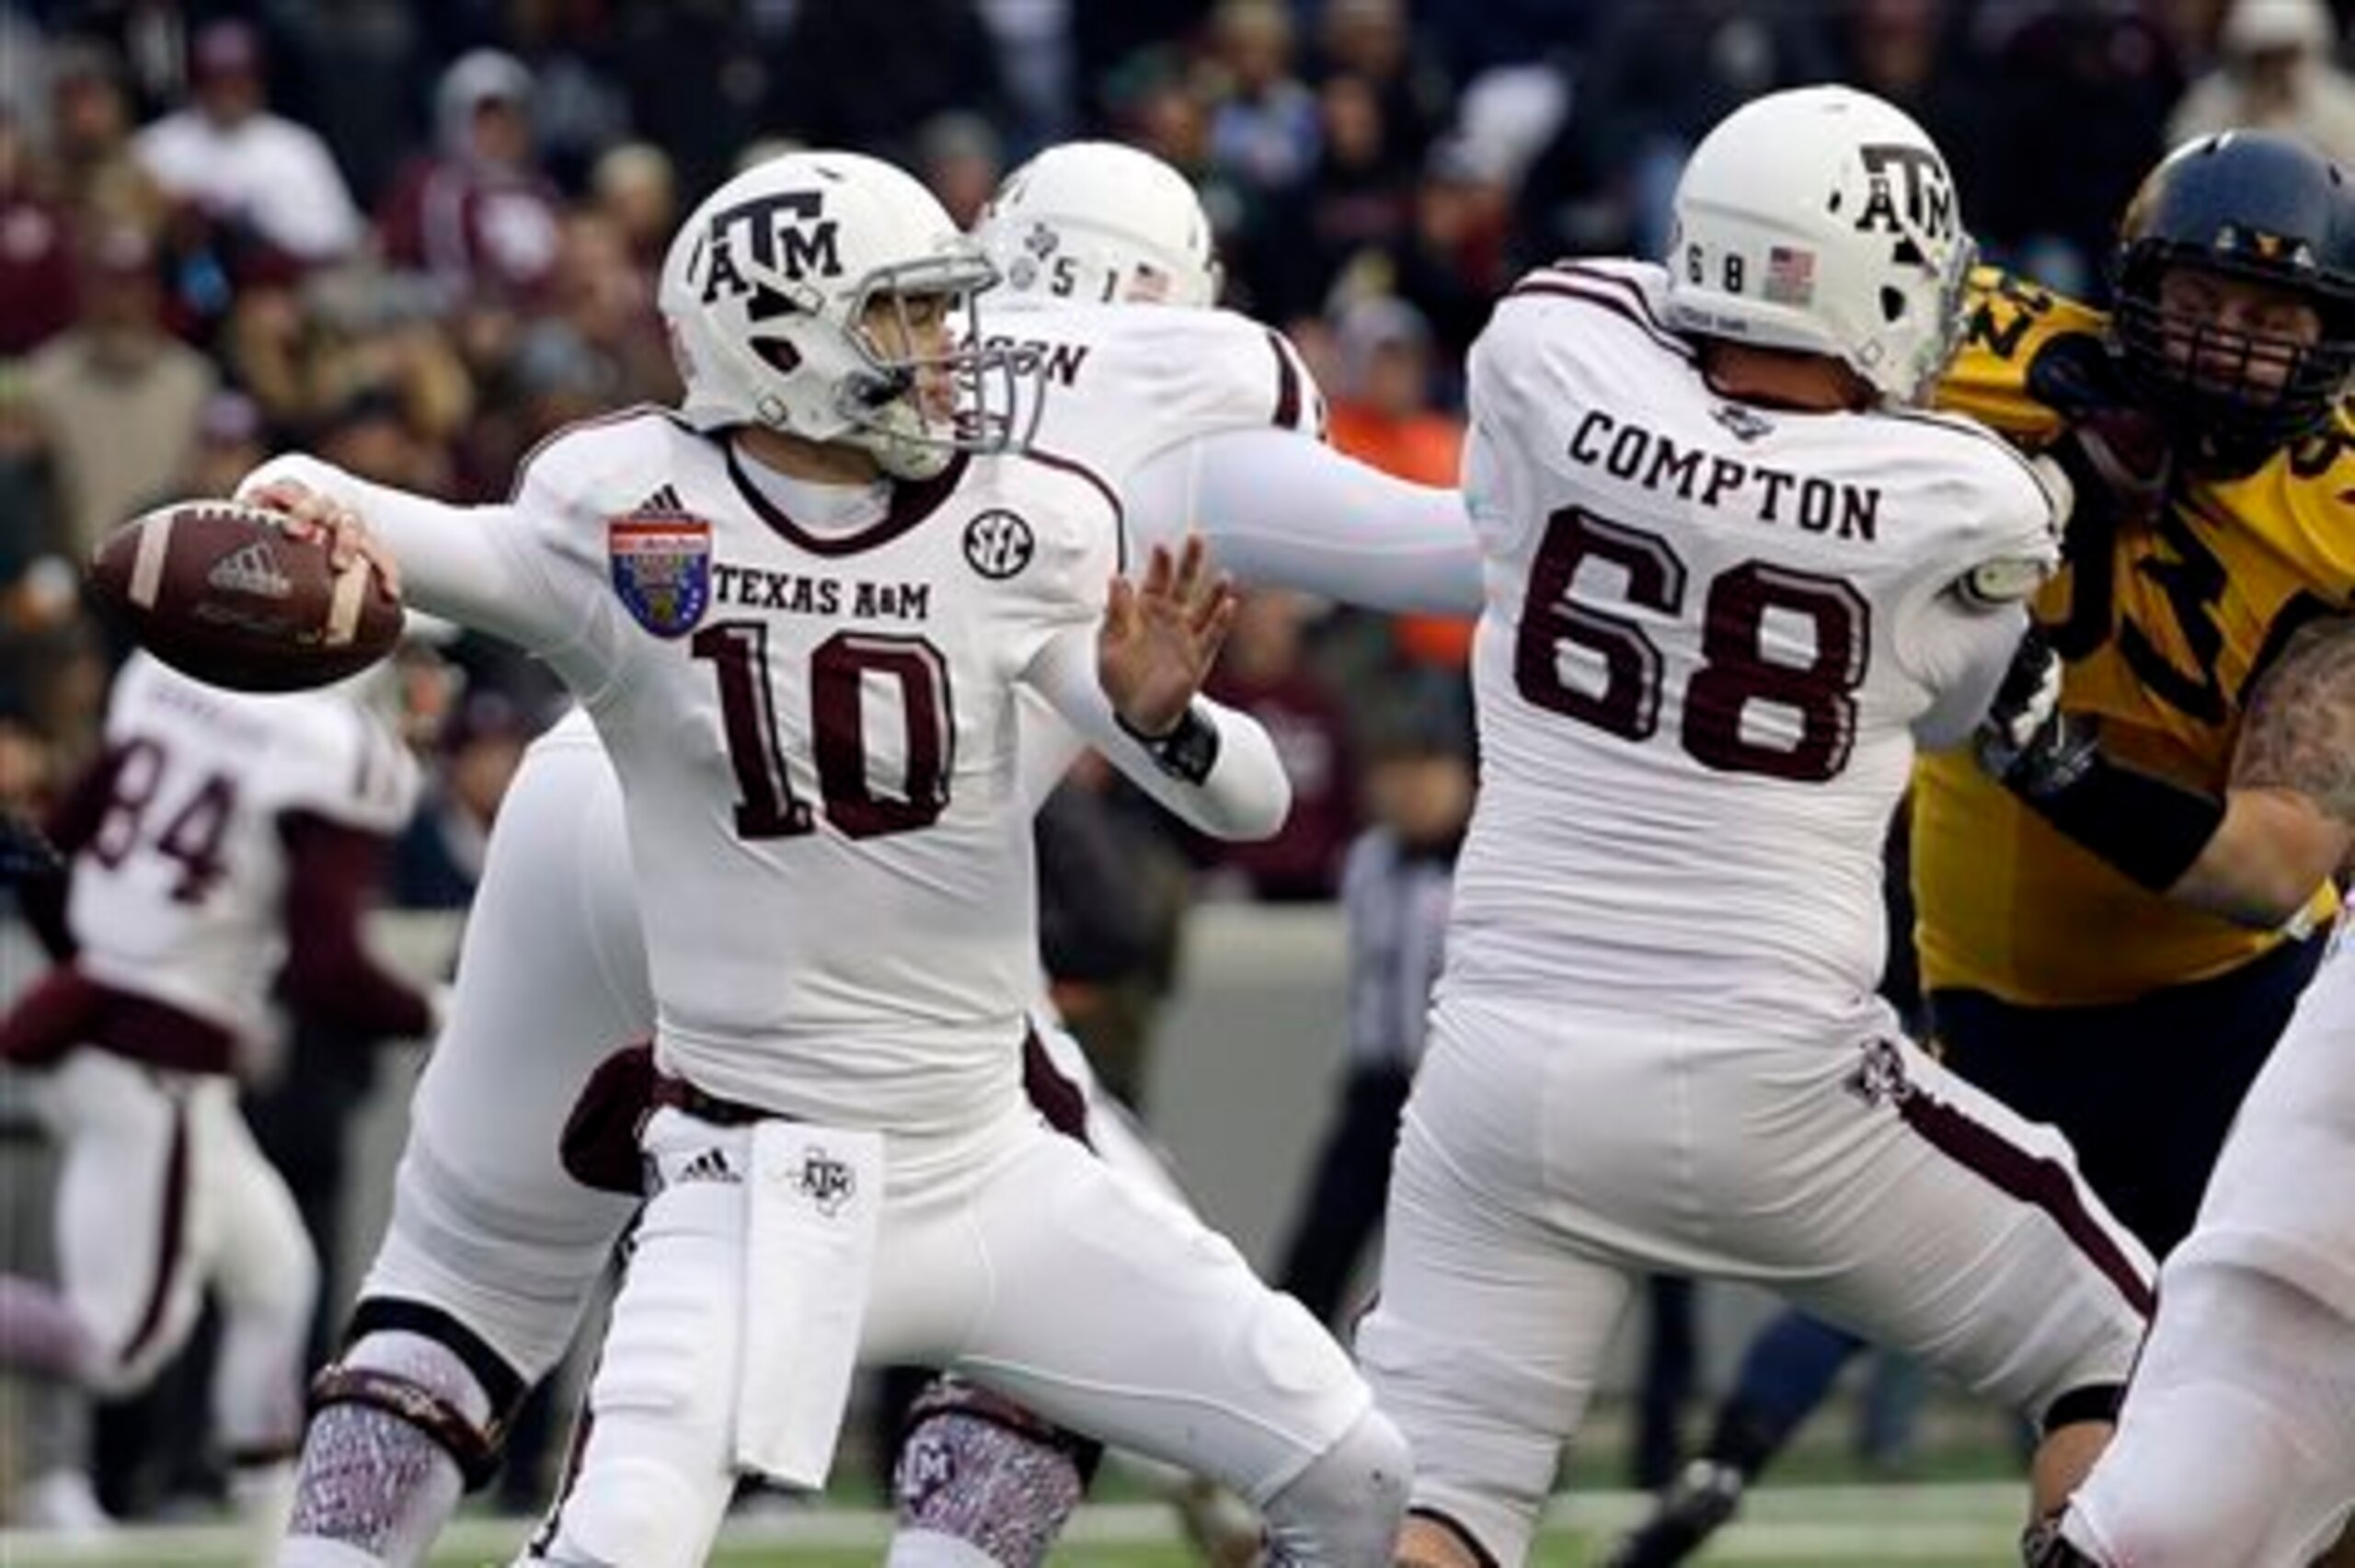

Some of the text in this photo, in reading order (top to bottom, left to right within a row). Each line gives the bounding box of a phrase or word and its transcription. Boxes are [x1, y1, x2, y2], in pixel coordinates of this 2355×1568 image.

[1568, 409, 1882, 543] COMPTON
[711, 563, 931, 621] TEXAS A&M
[1513, 503, 1871, 784] 68
[691, 618, 957, 841] 10
[92, 738, 239, 904] 84
